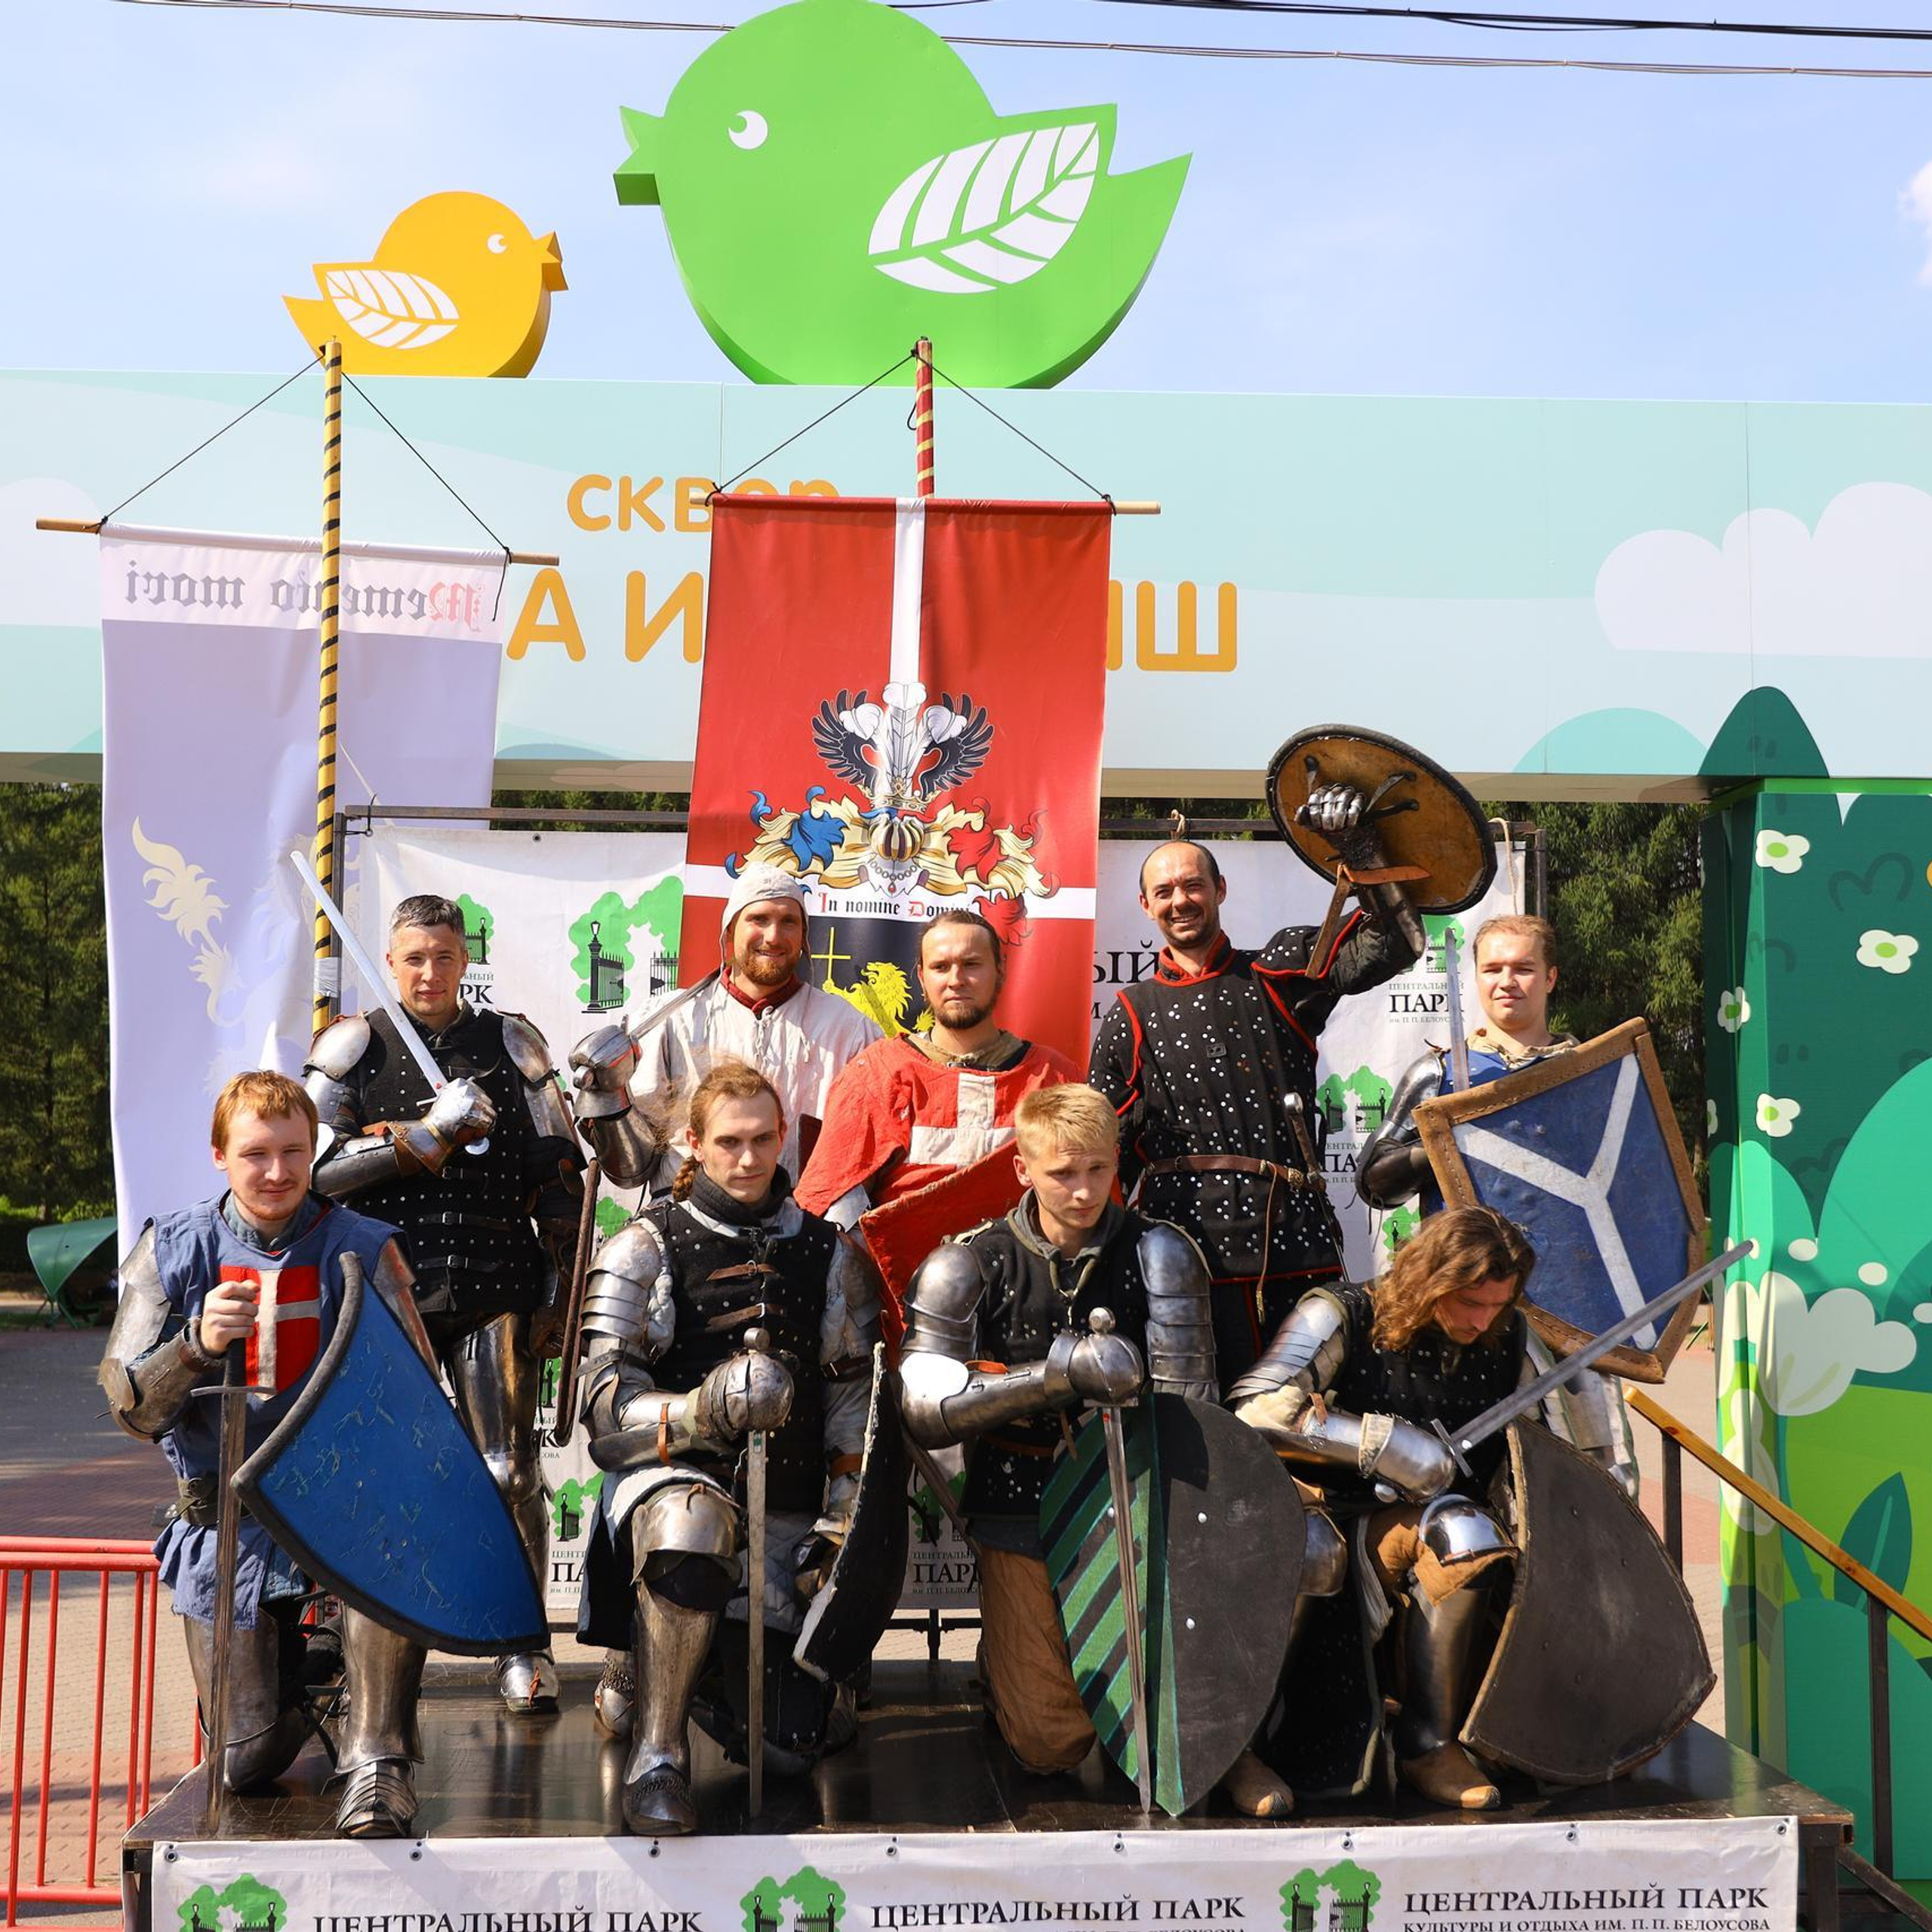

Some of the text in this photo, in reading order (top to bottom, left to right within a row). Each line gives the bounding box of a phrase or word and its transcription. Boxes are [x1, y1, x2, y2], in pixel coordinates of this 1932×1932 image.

[845, 897, 900, 915] nomine
[871, 1894, 1246, 1930] ЦЕНТРАЛЬНЫЙ ПАРК
[1404, 1882, 1770, 1916] ЦЕНТРАЛЬНЫЙ ПАРК
[313, 1904, 703, 1932] ЦЕНТРАЛЬНЫЙ ПАРК
[1404, 1919, 1770, 1932] КУЛЬТУРЫ И ОТДЫХА ИМ. П. П. БЕЛОУСОВА
